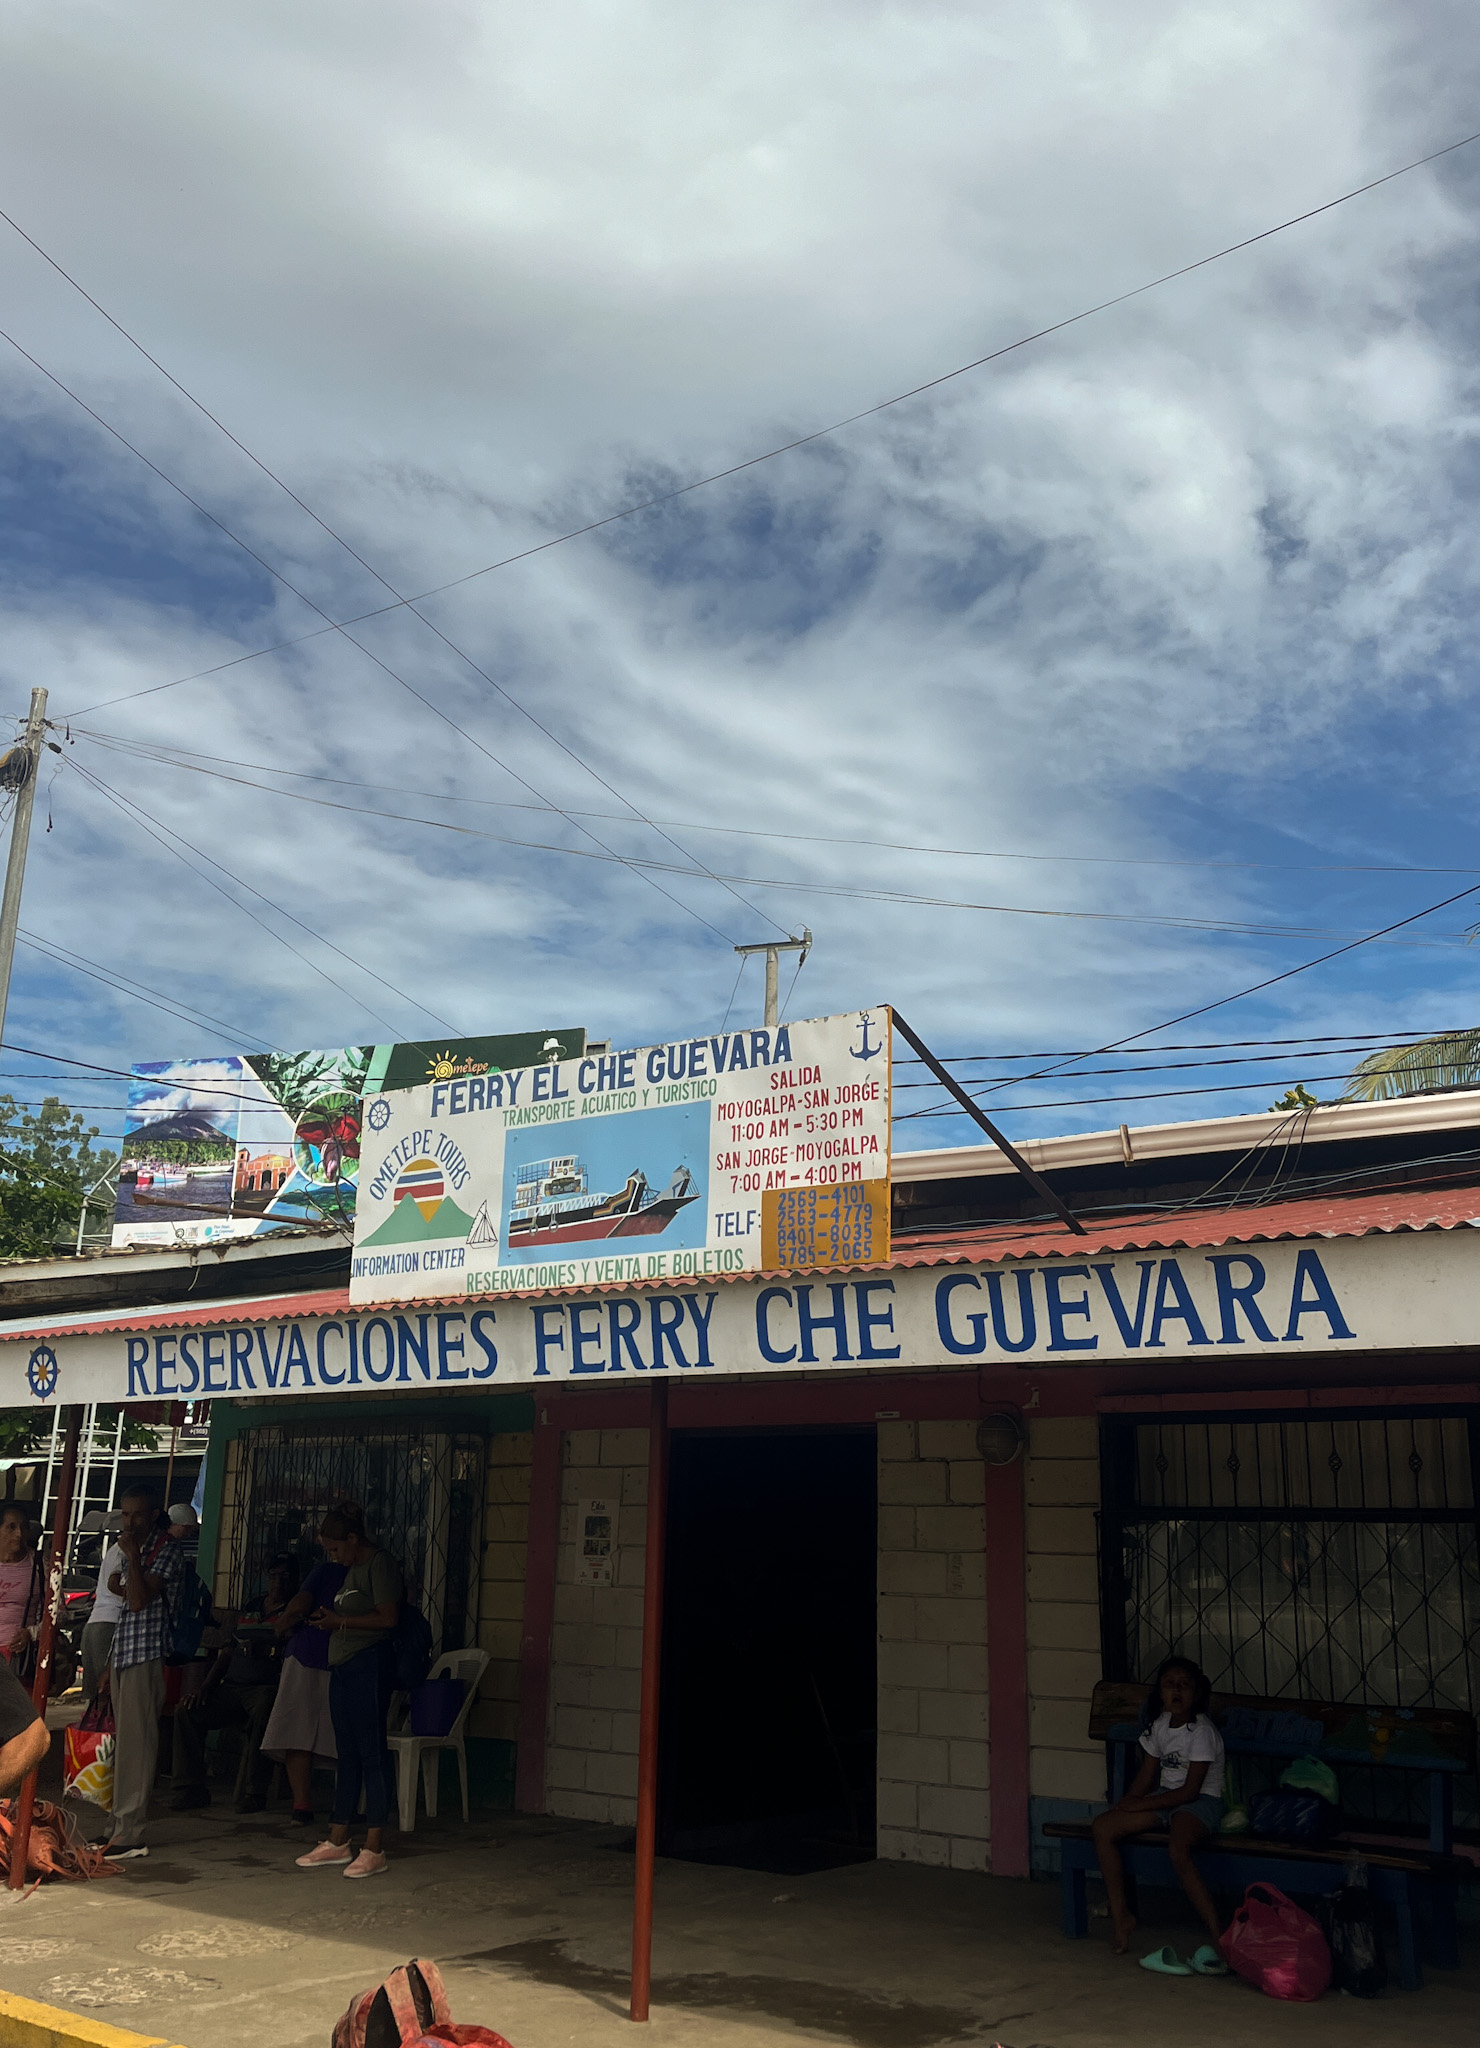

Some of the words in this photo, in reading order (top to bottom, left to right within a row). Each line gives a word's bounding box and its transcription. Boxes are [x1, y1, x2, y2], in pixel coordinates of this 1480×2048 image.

[430, 1071, 524, 1118] FERRY
[531, 1064, 569, 1102] EL
[577, 1052, 637, 1094] CHE
[645, 1027, 793, 1084] GUEVARA
[770, 1065, 822, 1090] SALIDA
[502, 1100, 576, 1127] TRANSPORTE
[581, 1091, 637, 1116] ACUATICO
[637, 1089, 650, 1106] Y
[655, 1078, 717, 1104] TURISTICO
[717, 1088, 829, 1121] MOYOGALPA-SAN
[834, 1081, 880, 1105] JORGE
[731, 1122, 765, 1142] 11:00
[769, 1118, 789, 1138] AM
[806, 1111, 838, 1133] 5:30
[842, 1108, 864, 1128] PM
[370, 1129, 433, 1201] OMETEPE
[434, 1132, 471, 1191] TOURS
[716, 1151, 741, 1171] SAN
[745, 1135, 879, 1168] JORGE-MOYOGALPA
[730, 1173, 761, 1194] 7:00
[765, 1170, 786, 1190] AM
[804, 1165, 838, 1185] 4:00
[842, 1161, 862, 1182] PM
[778, 1184, 866, 1210] 2569-4101
[715, 1210, 761, 1238] TELF:
[777, 1203, 873, 1229] 2563-4779
[777, 1222, 873, 1247] 8401-8035
[352, 1252, 420, 1278] INFORMATION
[423, 1247, 466, 1271] CENTER
[778, 1241, 872, 1266] 5785-2065
[466, 1264, 576, 1293] RESERVACIONES
[581, 1262, 591, 1284] Y
[595, 1257, 641, 1282] VENTA
[647, 1254, 667, 1279] DE
[672, 1248, 744, 1276] BOLETOS
[124, 1309, 499, 1397] RESERVACIONES
[529, 1291, 719, 1377] FERRY
[756, 1278, 902, 1364] CHE
[934, 1248, 1358, 1356] GUEVARA
